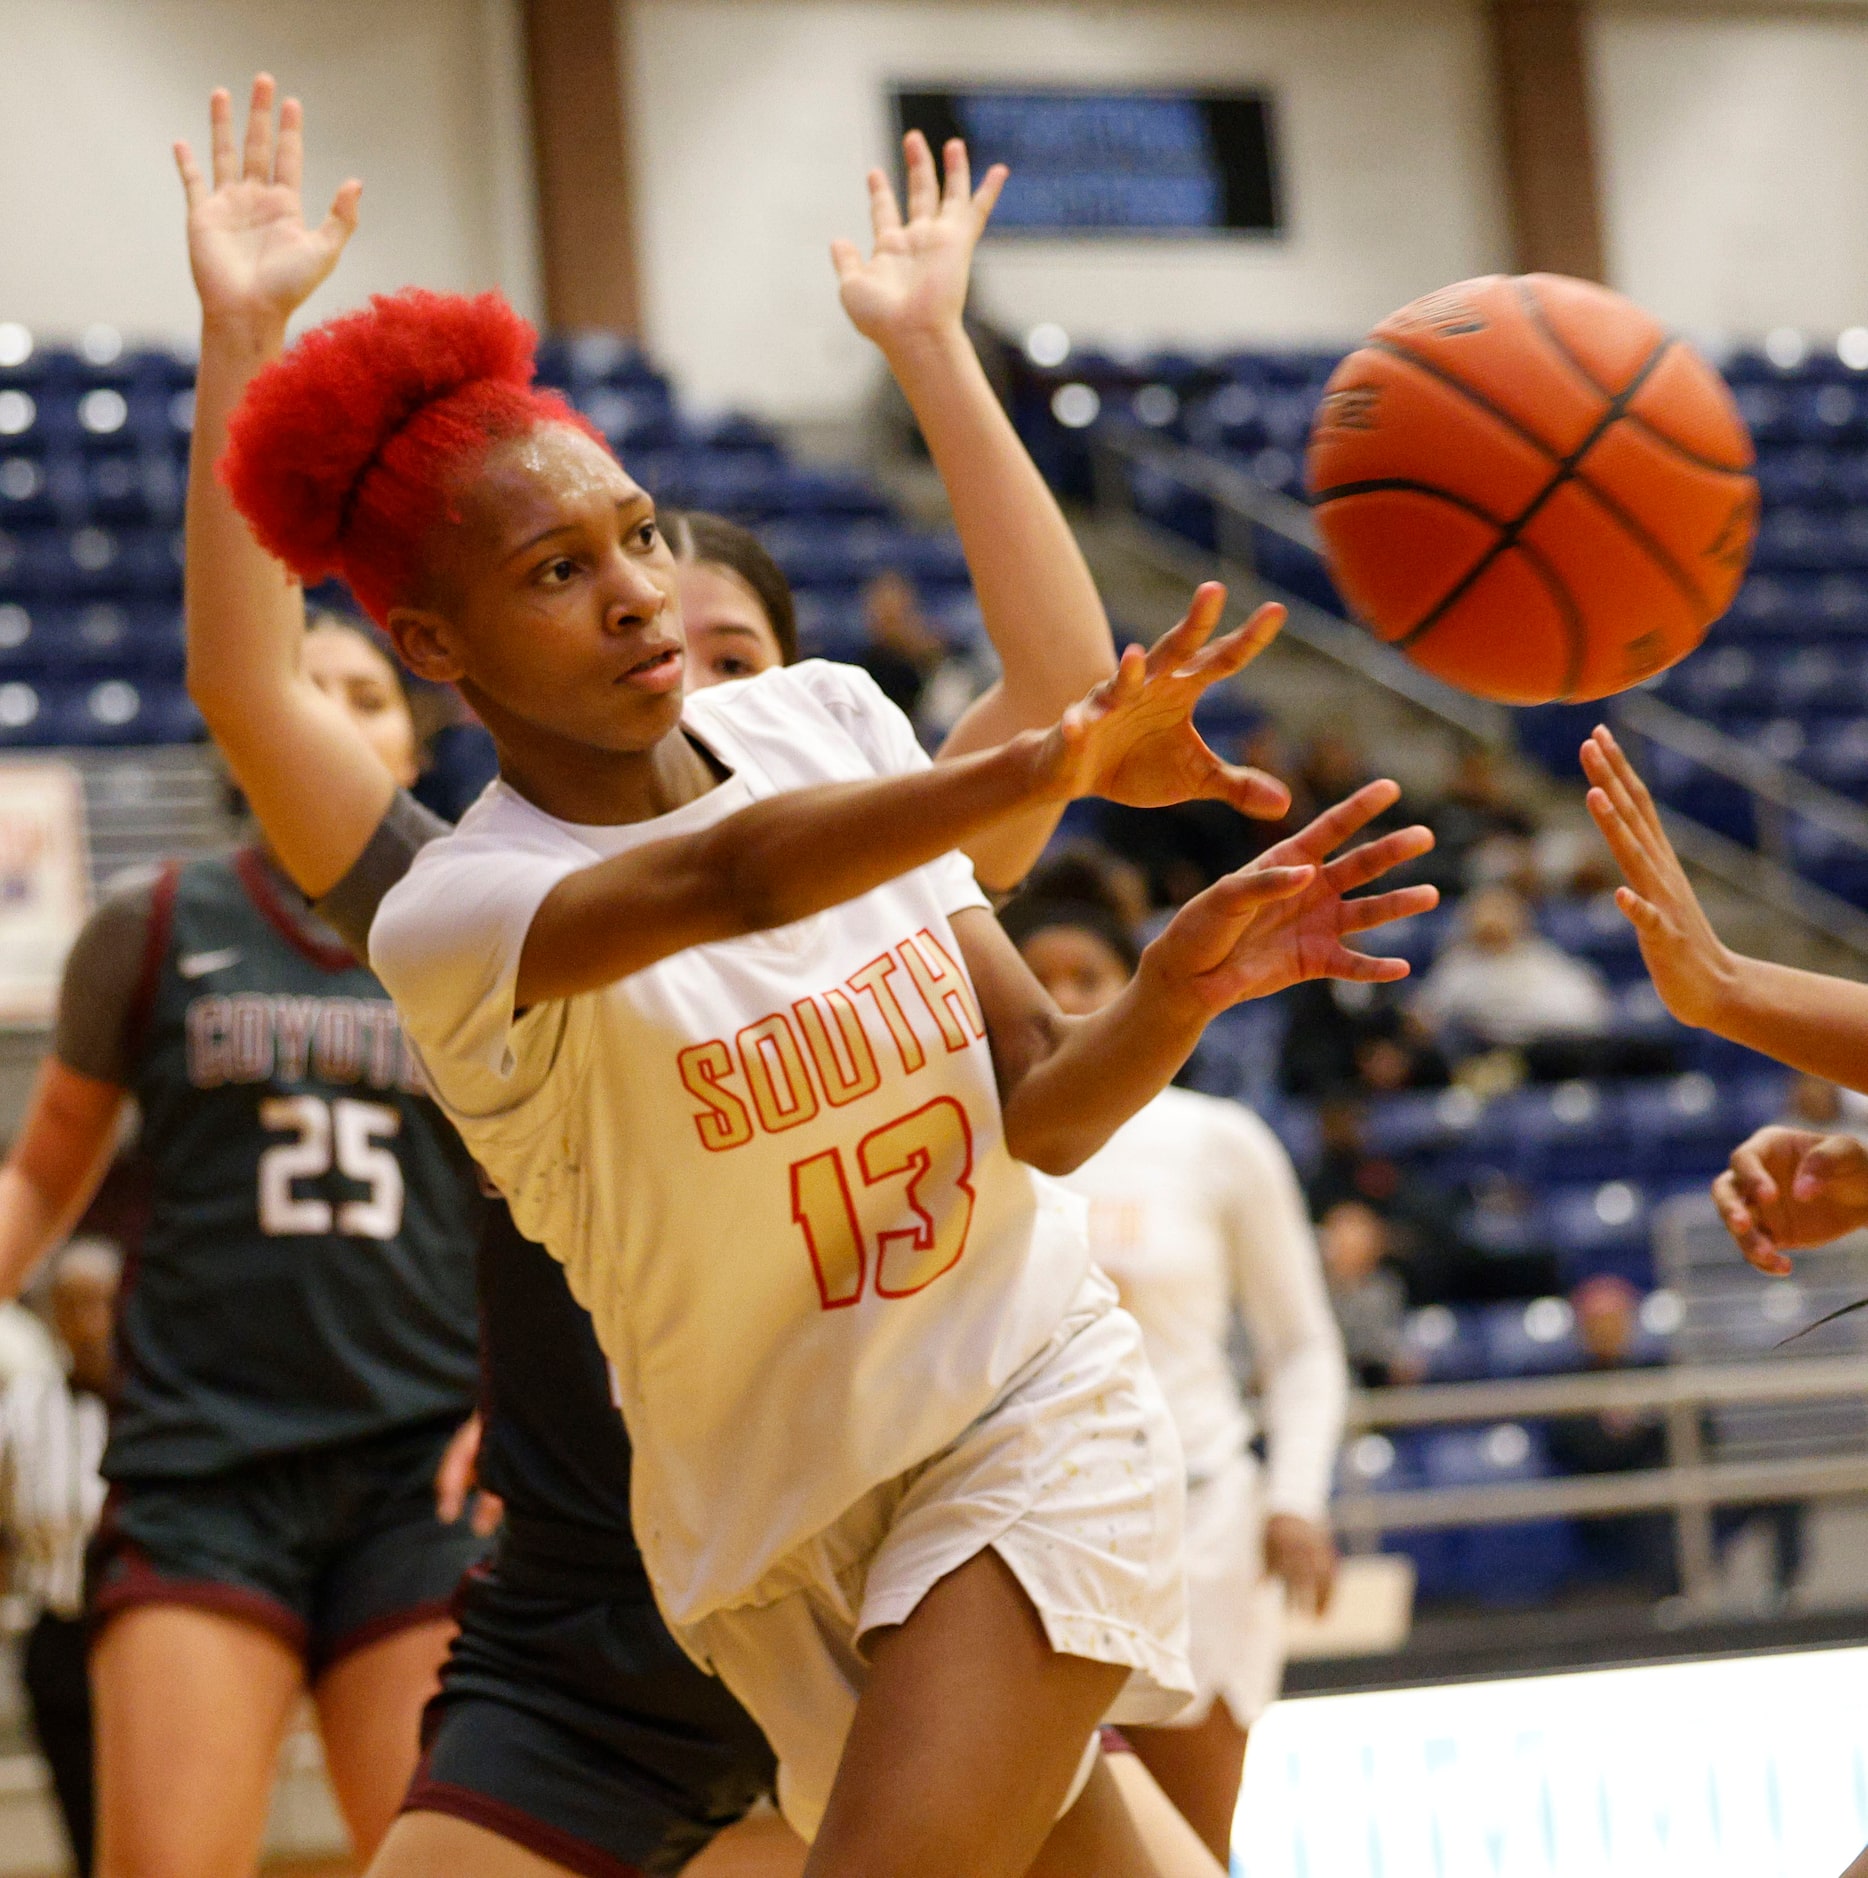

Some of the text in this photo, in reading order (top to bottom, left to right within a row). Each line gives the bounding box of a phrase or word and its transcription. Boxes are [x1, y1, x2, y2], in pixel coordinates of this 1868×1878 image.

[677, 928, 986, 1152] SOUTH
[258, 1096, 404, 1240] 25
[789, 1095, 976, 1311] 13
